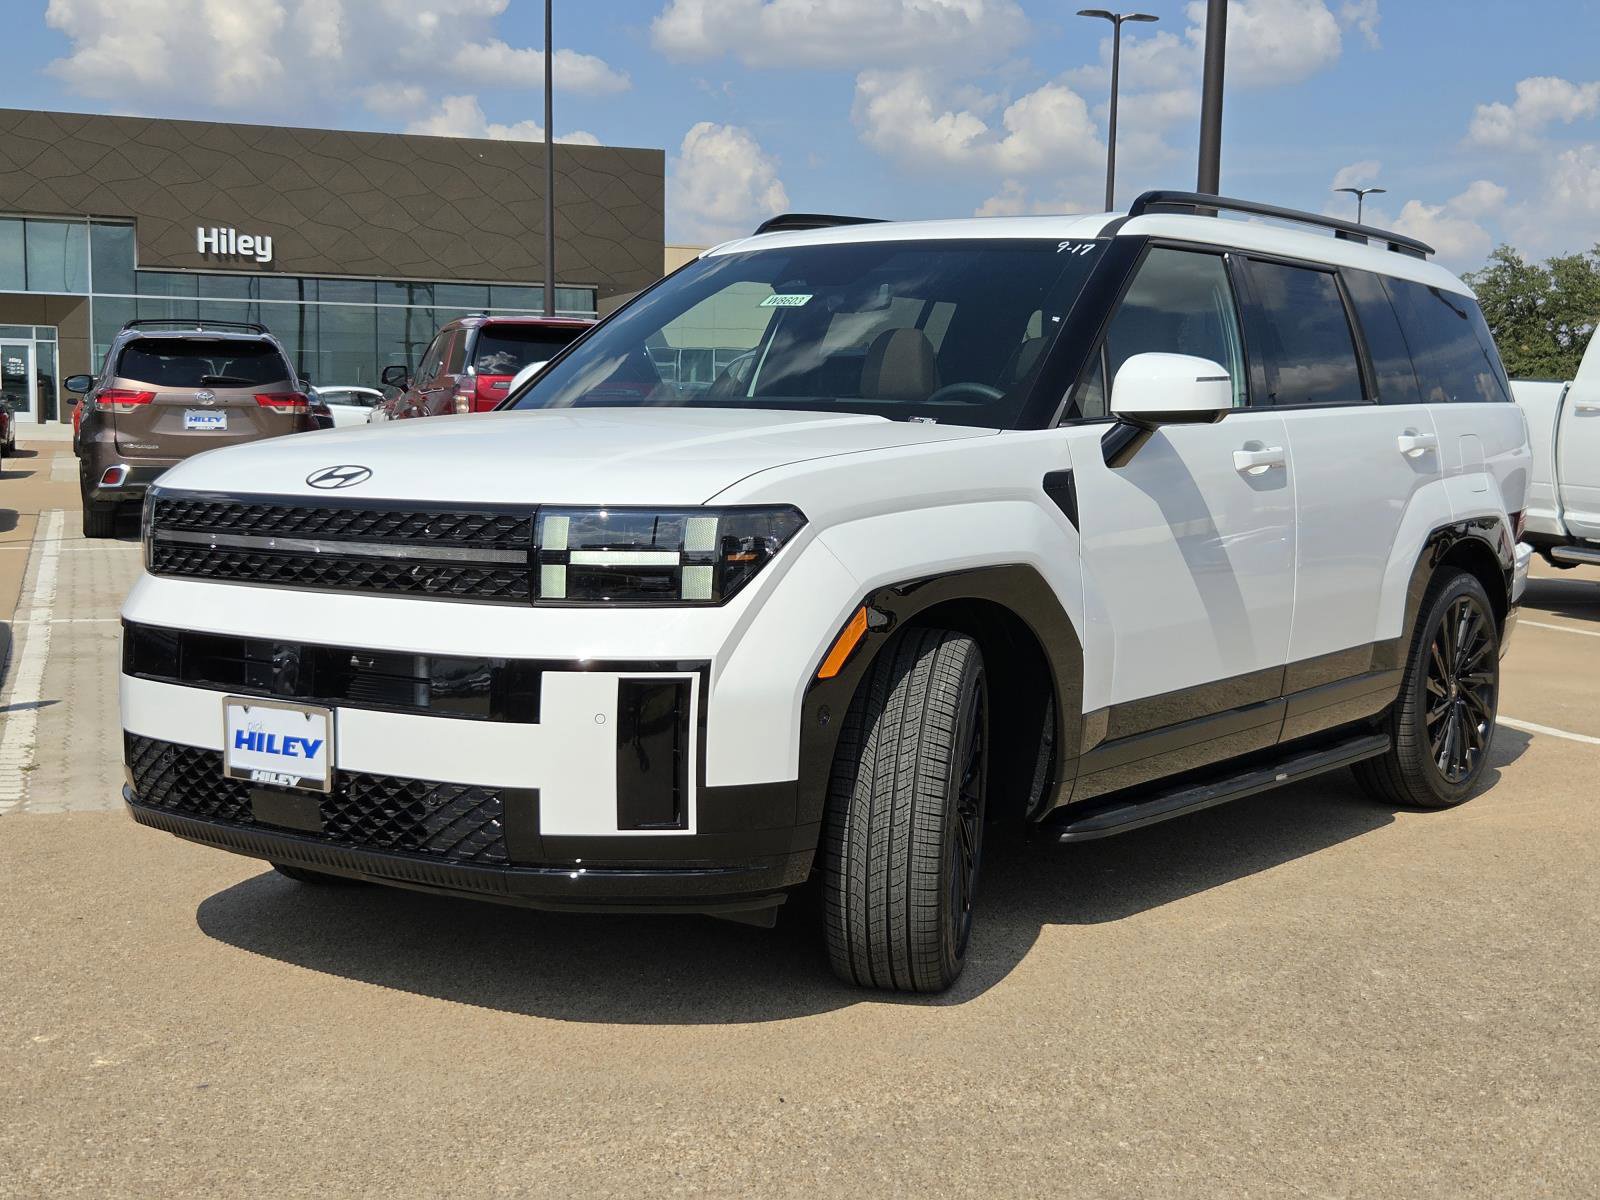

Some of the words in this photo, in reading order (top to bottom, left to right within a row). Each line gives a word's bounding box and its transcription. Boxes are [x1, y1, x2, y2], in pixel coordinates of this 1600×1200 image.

[197, 227, 272, 262] Hiley
[1057, 241, 1096, 256] 9-17
[767, 296, 806, 305] W8603
[235, 729, 324, 759] HILEY
[252, 769, 302, 787] HILEY
